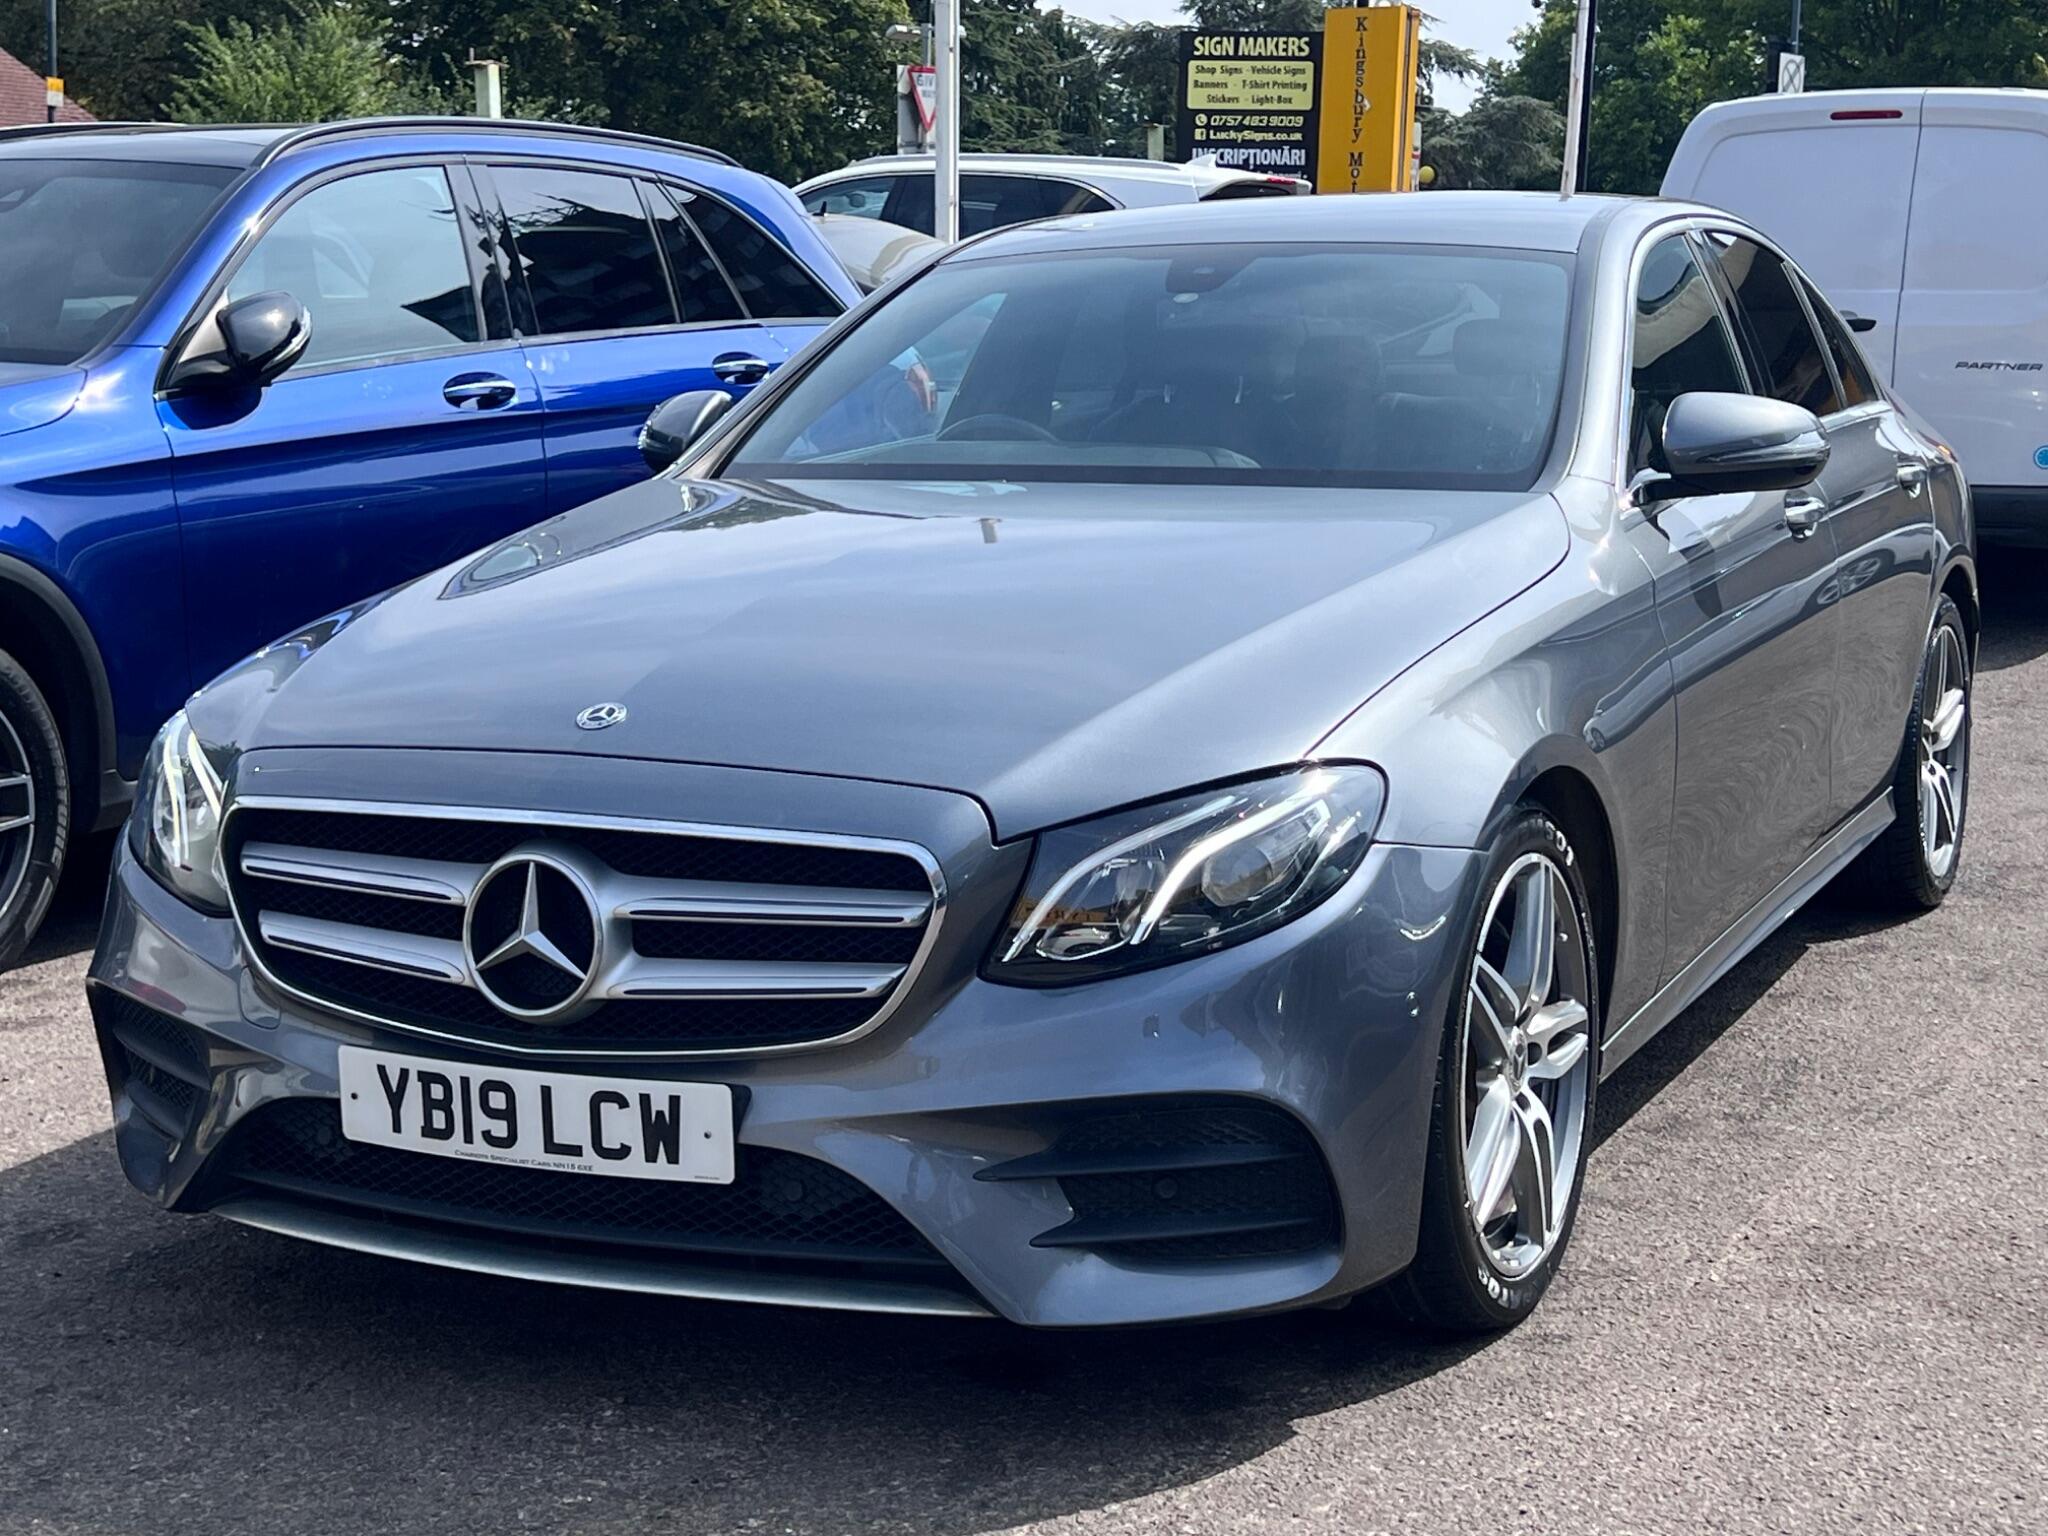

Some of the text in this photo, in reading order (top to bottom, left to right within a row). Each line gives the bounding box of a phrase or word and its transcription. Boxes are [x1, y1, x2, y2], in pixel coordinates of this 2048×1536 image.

[1193, 36, 1310, 57] SIGN MAKERS
[1195, 65, 1217, 76] Shop
[1220, 65, 1243, 76] Signs
[1251, 65, 1282, 75] Vehicle
[1283, 66, 1307, 77] Signs
[1193, 80, 1229, 89] Banners
[1242, 80, 1271, 89] T-Shirt
[1272, 80, 1308, 92] Printing
[1351, 17, 1368, 144] Kingsbury
[1206, 94, 1240, 104] Stickers
[1210, 115, 1243, 127] 0757
[1209, 129, 1303, 143] LuckySigns.co.uk
[1954, 361, 2044, 372] PARTNER
[376, 1063, 682, 1166] YB19 LCW
